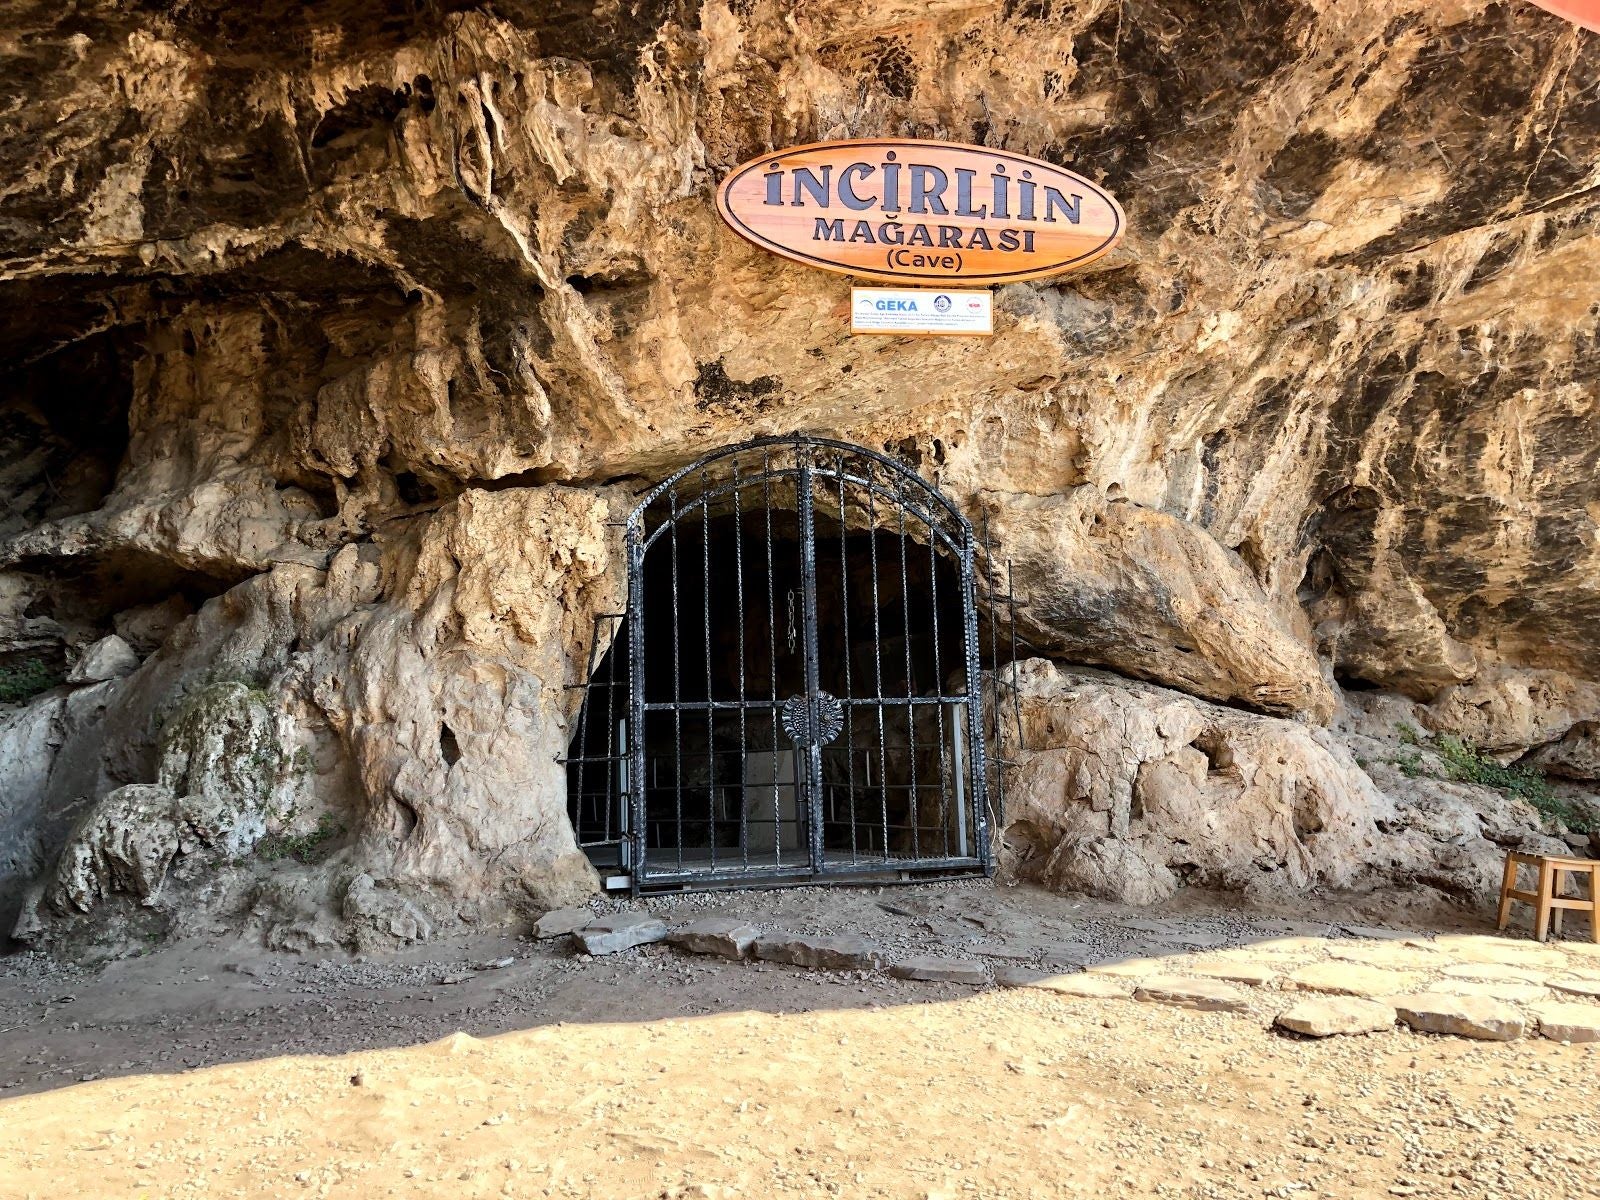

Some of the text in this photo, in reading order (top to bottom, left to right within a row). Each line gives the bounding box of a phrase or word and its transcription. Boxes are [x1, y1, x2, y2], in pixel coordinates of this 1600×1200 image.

[763, 151, 1082, 224] İNCİRLİİN
[813, 215, 1035, 253] MAĞARASI
[886, 249, 963, 272] (Cave)
[876, 300, 918, 311] GEKA
